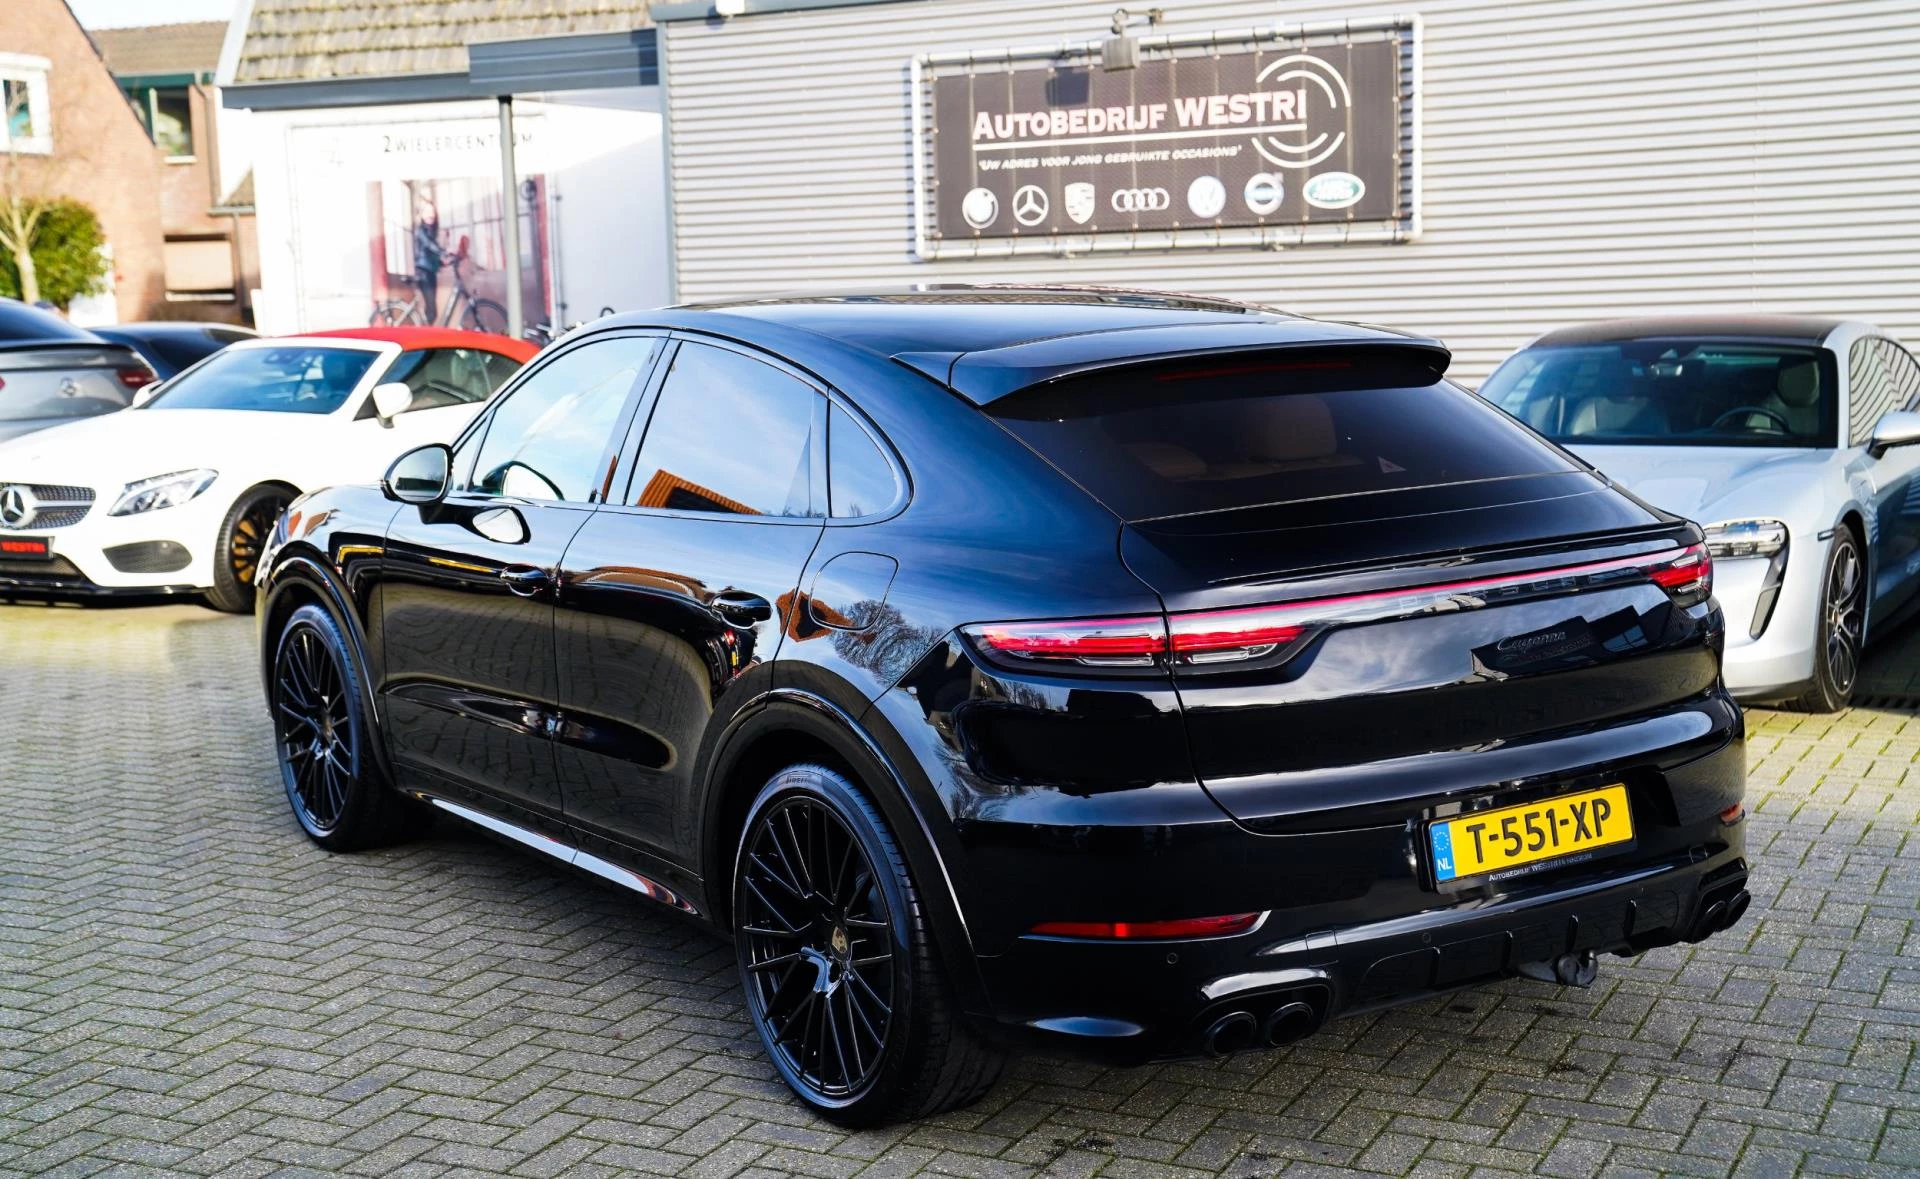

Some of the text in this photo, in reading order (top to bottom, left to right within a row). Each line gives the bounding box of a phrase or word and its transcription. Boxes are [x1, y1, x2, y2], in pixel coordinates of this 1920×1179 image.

[973, 89, 1308, 141] AUTOBEDRIJF WESTRI
[382, 131, 533, 153] 2WIELERCENTM
[1001, 157, 1039, 169] ADRES
[1041, 155, 1071, 167] VOOR
[1071, 153, 1103, 166] JONG
[1104, 150, 1171, 164] GEBRUIKTE
[1466, 797, 1612, 864] T-551-XP
[1437, 857, 1452, 872] NL
